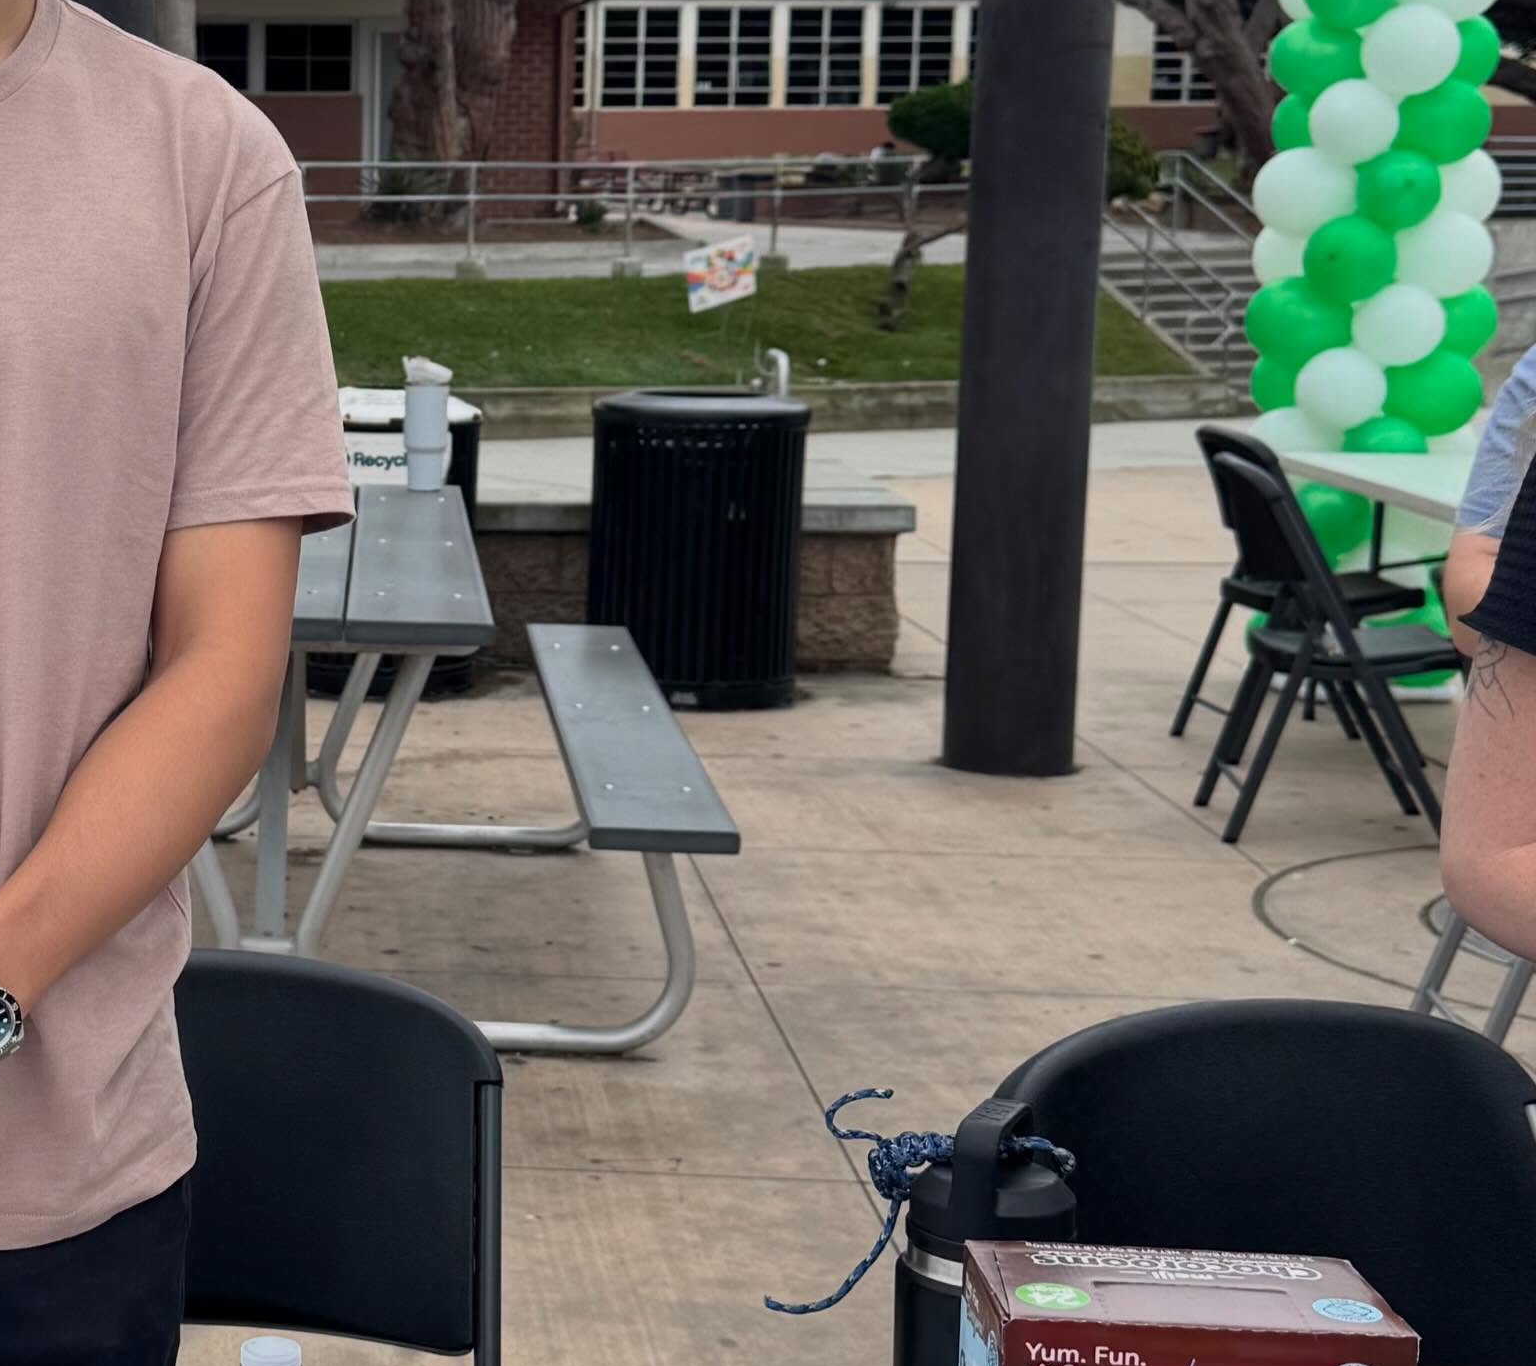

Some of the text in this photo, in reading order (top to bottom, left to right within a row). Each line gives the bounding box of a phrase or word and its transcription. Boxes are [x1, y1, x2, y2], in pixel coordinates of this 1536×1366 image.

[353, 452, 409, 471] Recycl
[1026, 1342, 1147, 1366] Yum. Fun.
